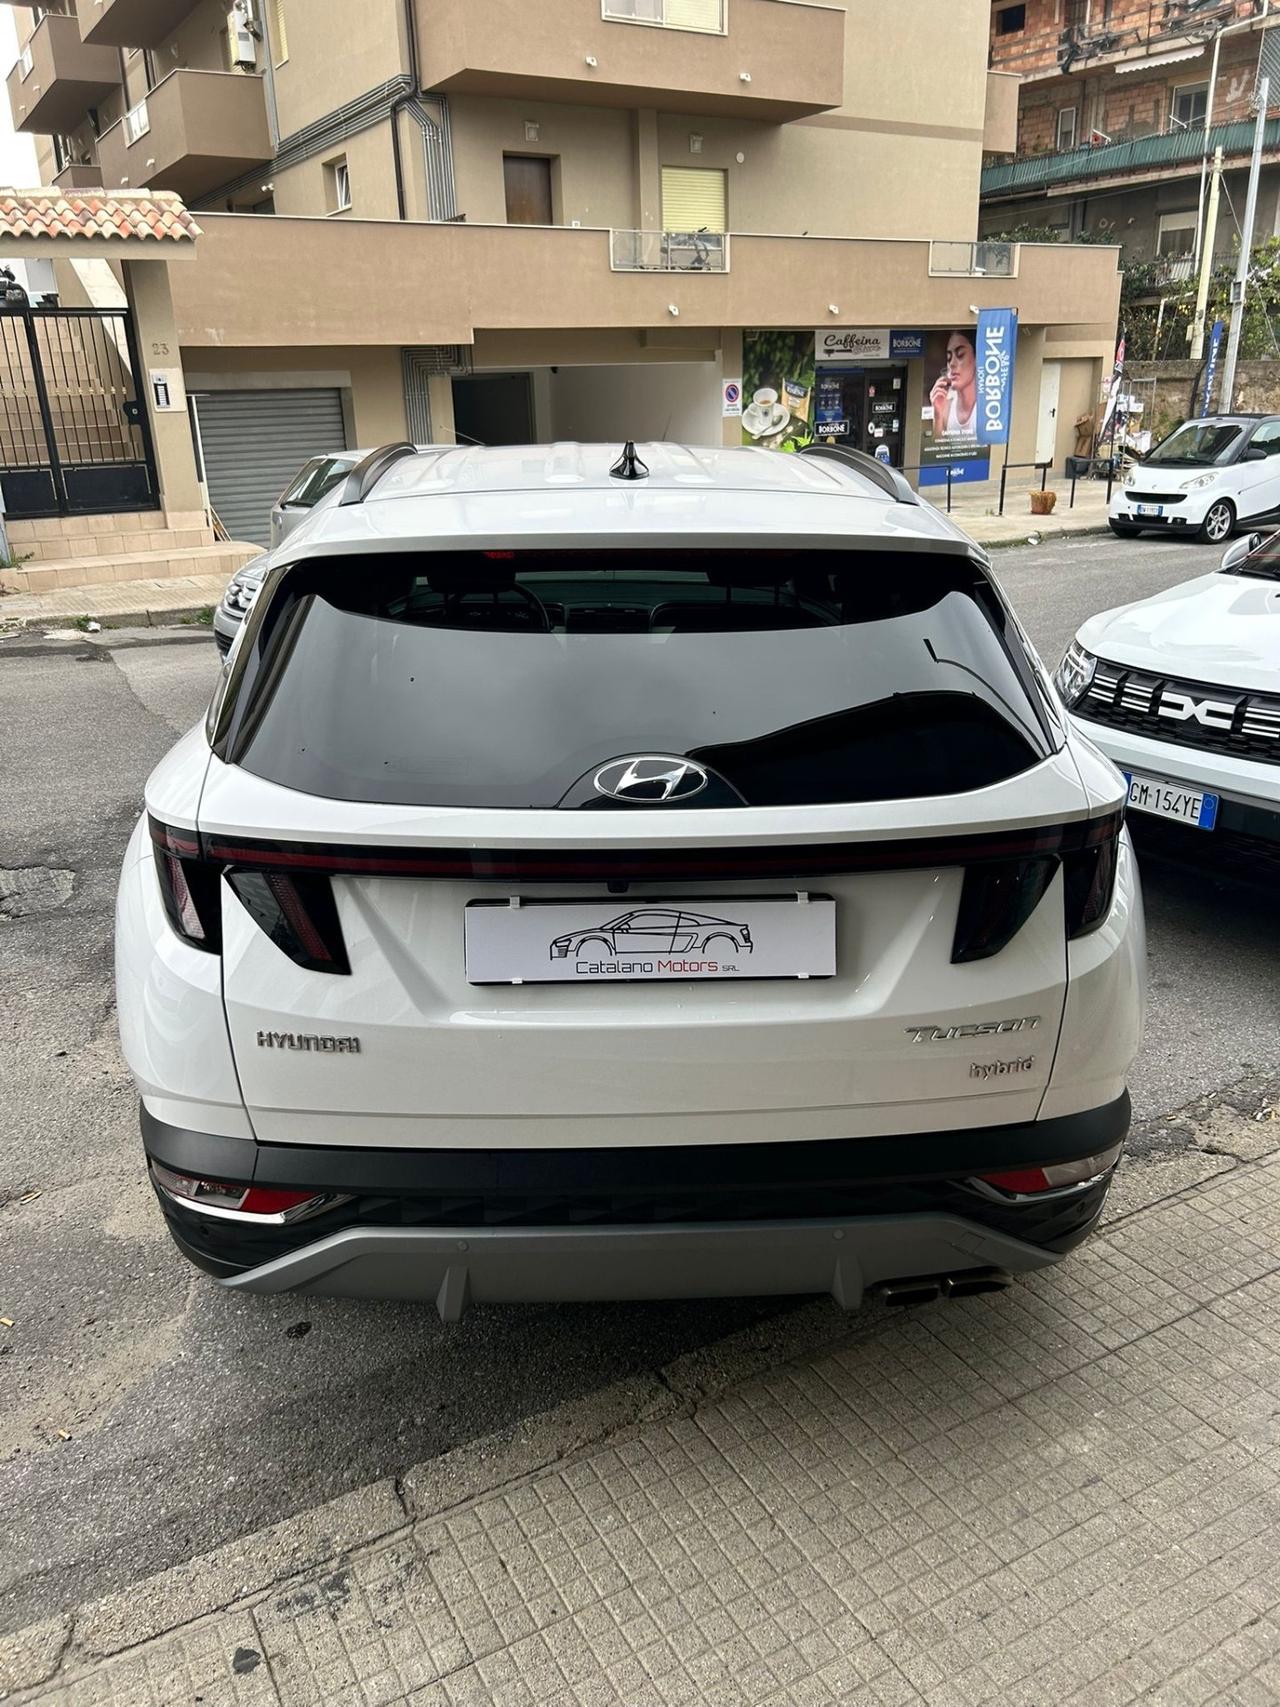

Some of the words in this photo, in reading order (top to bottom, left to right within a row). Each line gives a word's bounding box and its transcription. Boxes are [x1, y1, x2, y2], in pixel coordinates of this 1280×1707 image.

[824, 334, 880, 349] Caffeina
[152, 343, 169, 356] 23
[575, 960, 653, 975] Catalano
[657, 960, 718, 973] Motors
[721, 964, 741, 972] SRL
[256, 1031, 361, 1053] HYUNDAI
[969, 1055, 1035, 1080] hybrid
